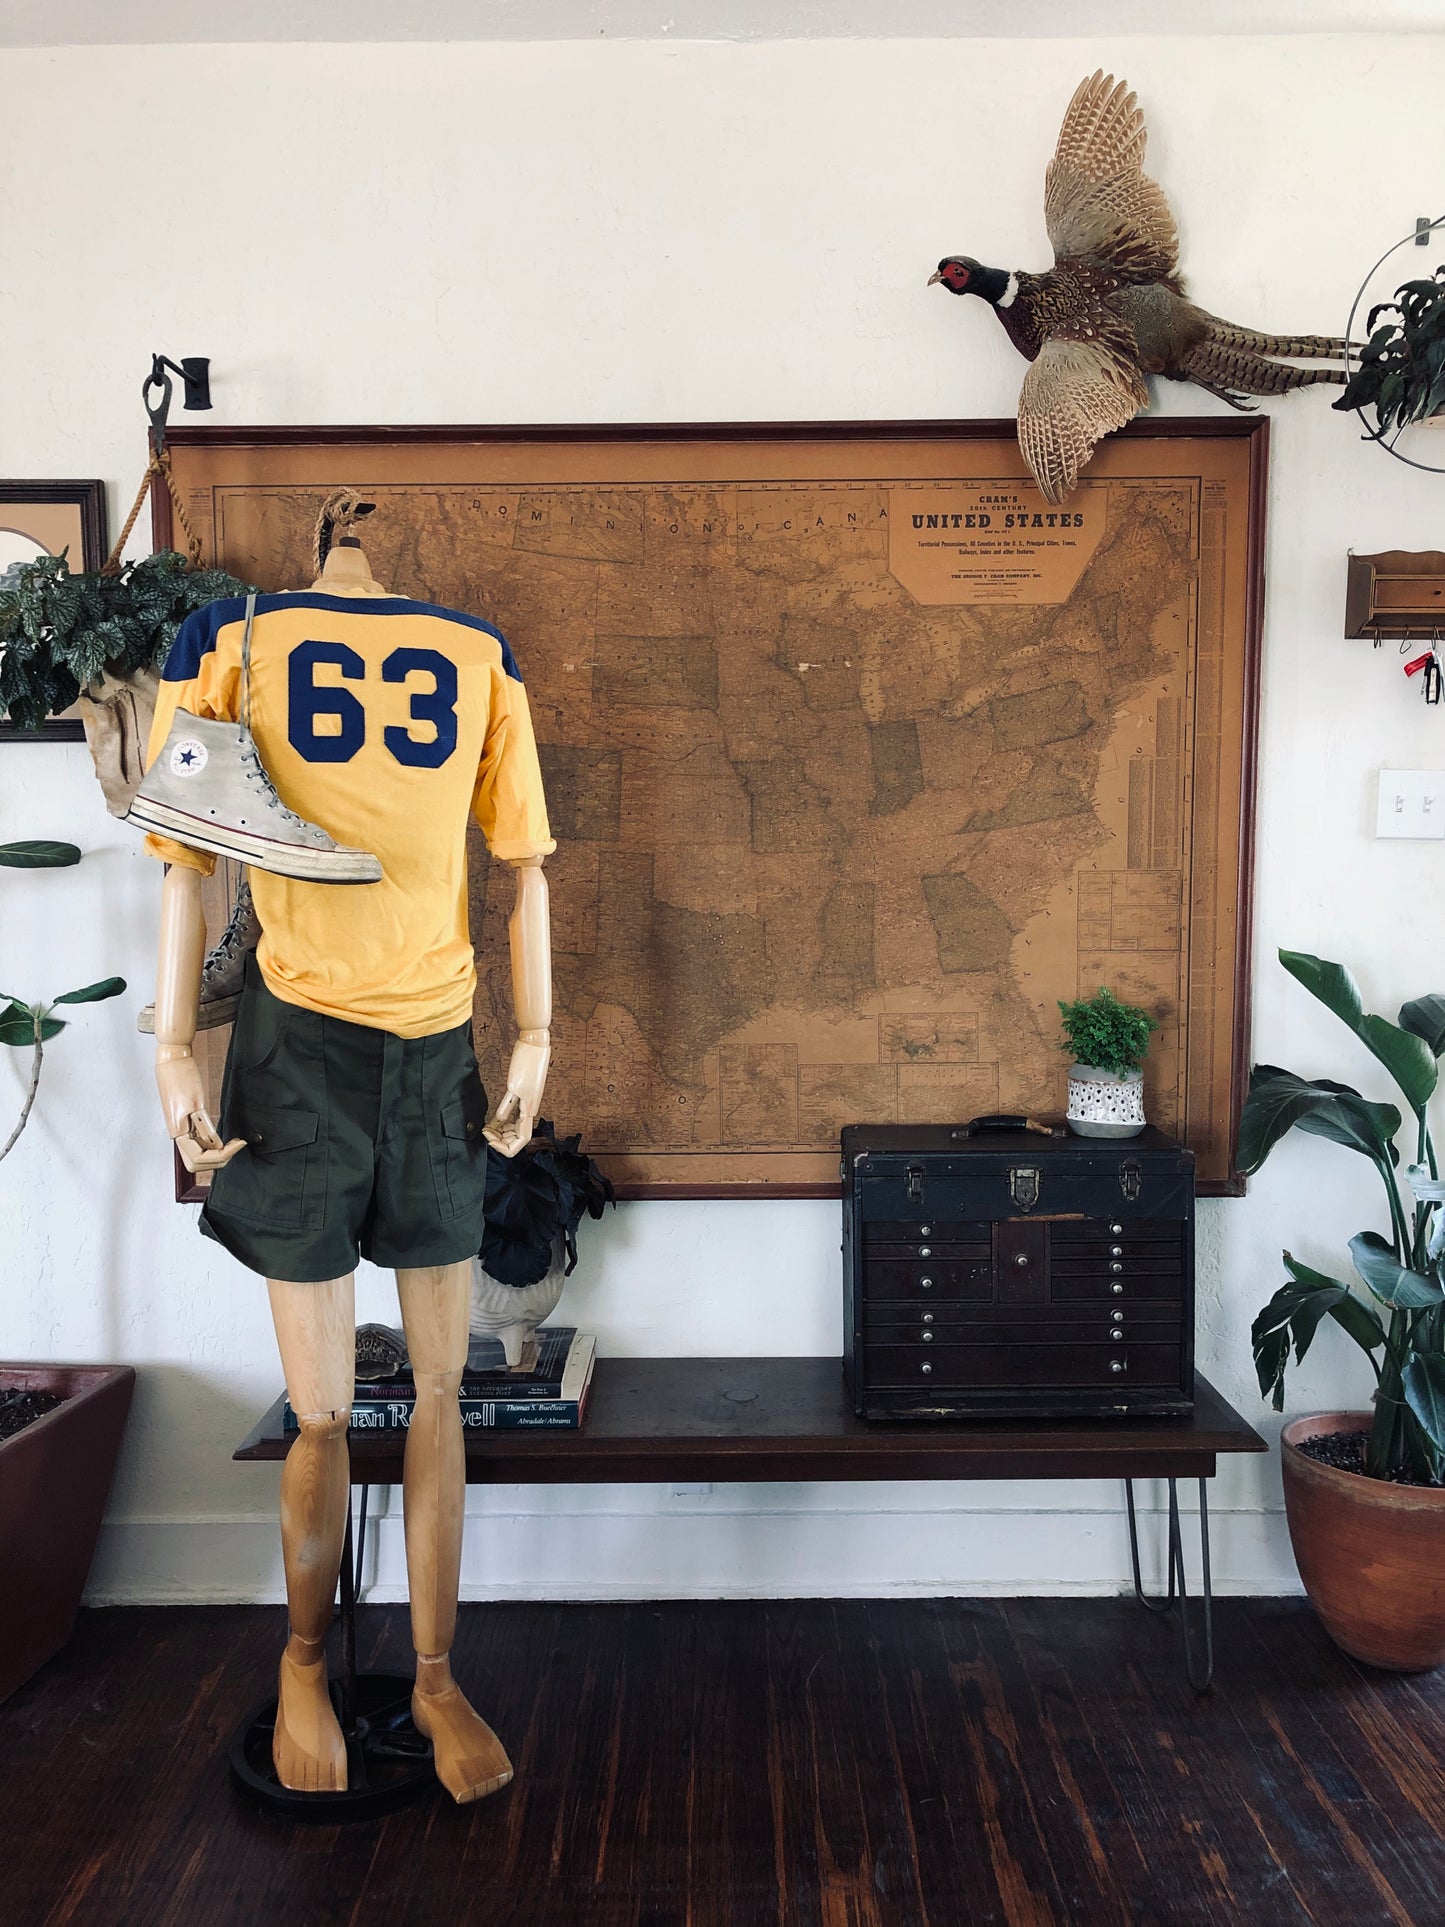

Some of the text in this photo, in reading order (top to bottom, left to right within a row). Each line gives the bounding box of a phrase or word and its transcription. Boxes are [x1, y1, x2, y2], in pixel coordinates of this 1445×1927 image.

[911, 513, 1084, 529] UNITED STATES
[288, 640, 458, 769] 63
[371, 1387, 410, 1396] Norman
